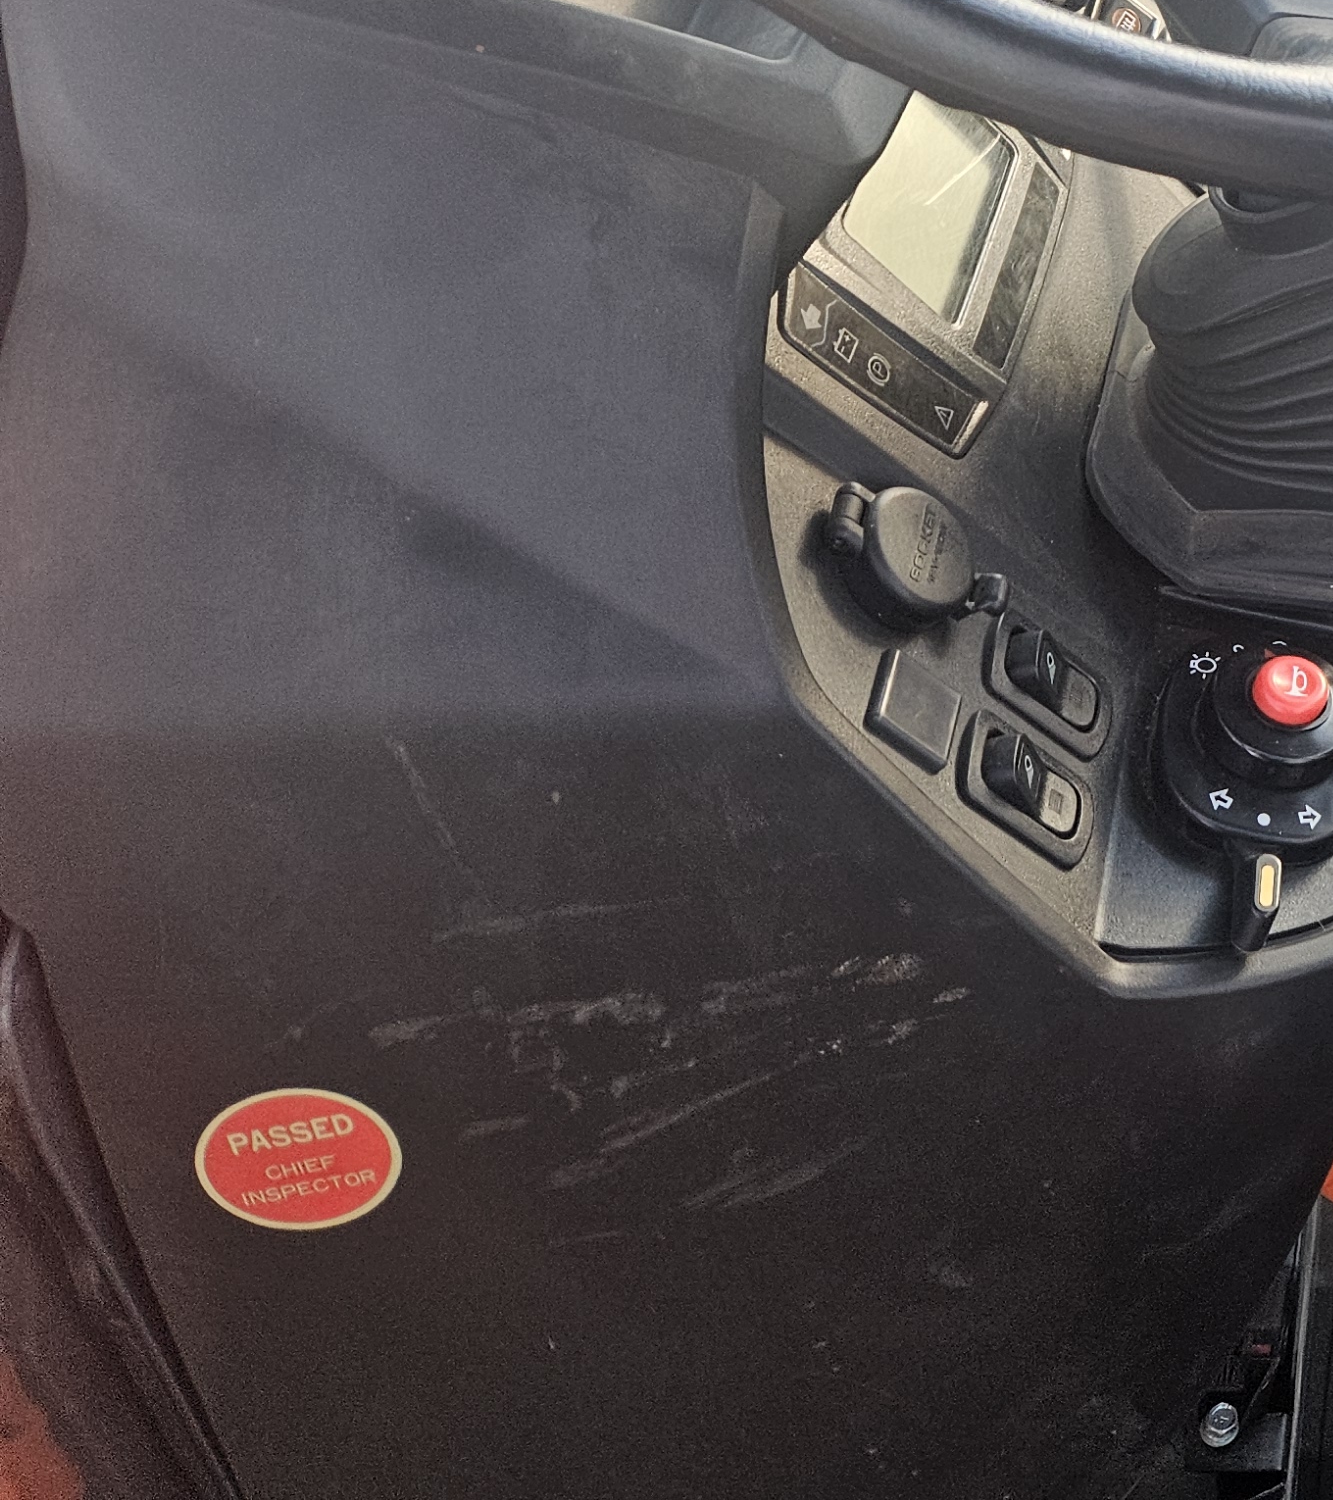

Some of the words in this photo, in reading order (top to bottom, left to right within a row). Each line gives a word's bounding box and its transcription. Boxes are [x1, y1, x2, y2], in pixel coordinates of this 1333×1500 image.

[227, 1113, 354, 1156] PASSED
[265, 1154, 336, 1181] CHIEF
[241, 1169, 376, 1207] INSPECTOR
